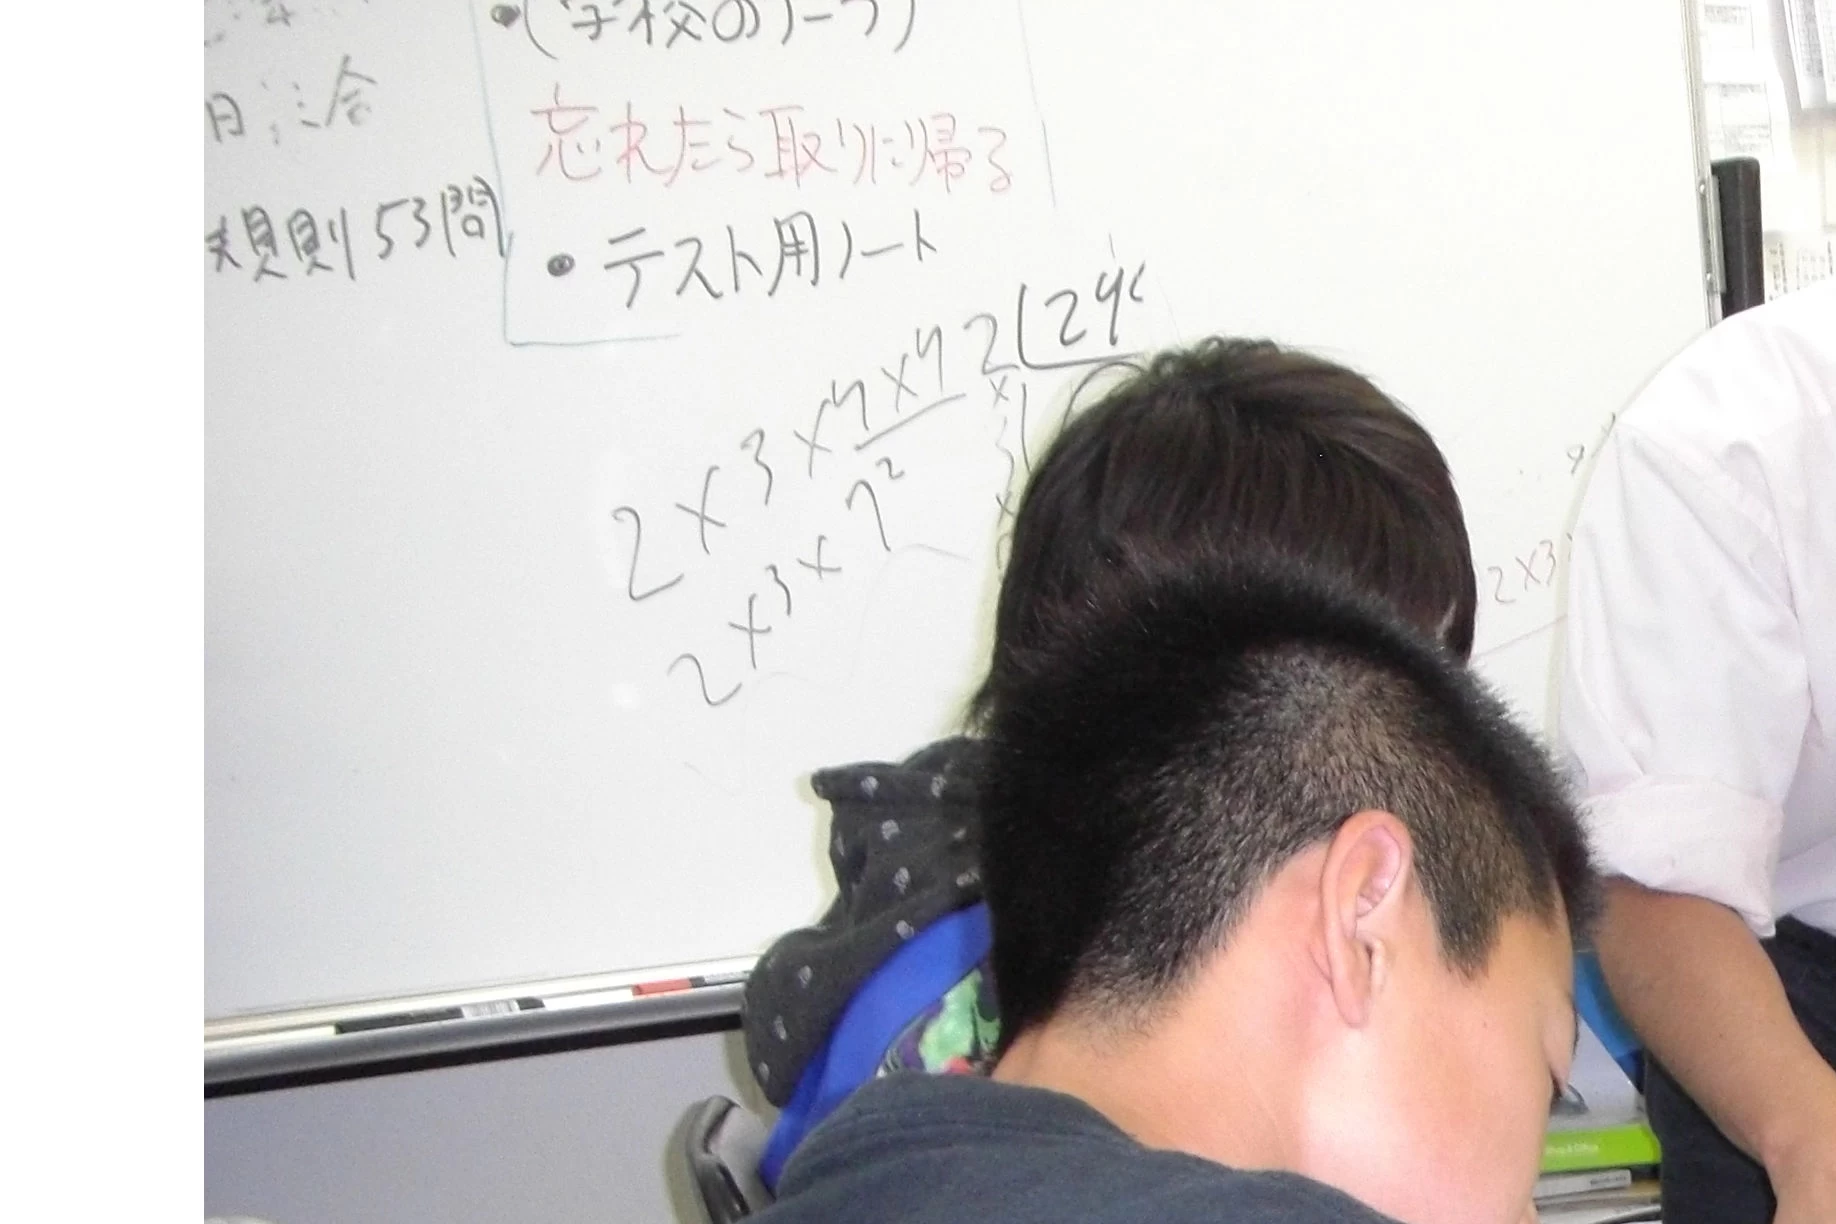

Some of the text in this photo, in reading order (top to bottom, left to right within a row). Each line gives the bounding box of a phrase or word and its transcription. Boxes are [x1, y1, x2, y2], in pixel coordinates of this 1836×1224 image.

[532, 82, 1014, 193] 忘れたら取りに帰る
[603, 210, 937, 308] テスト用ノート
